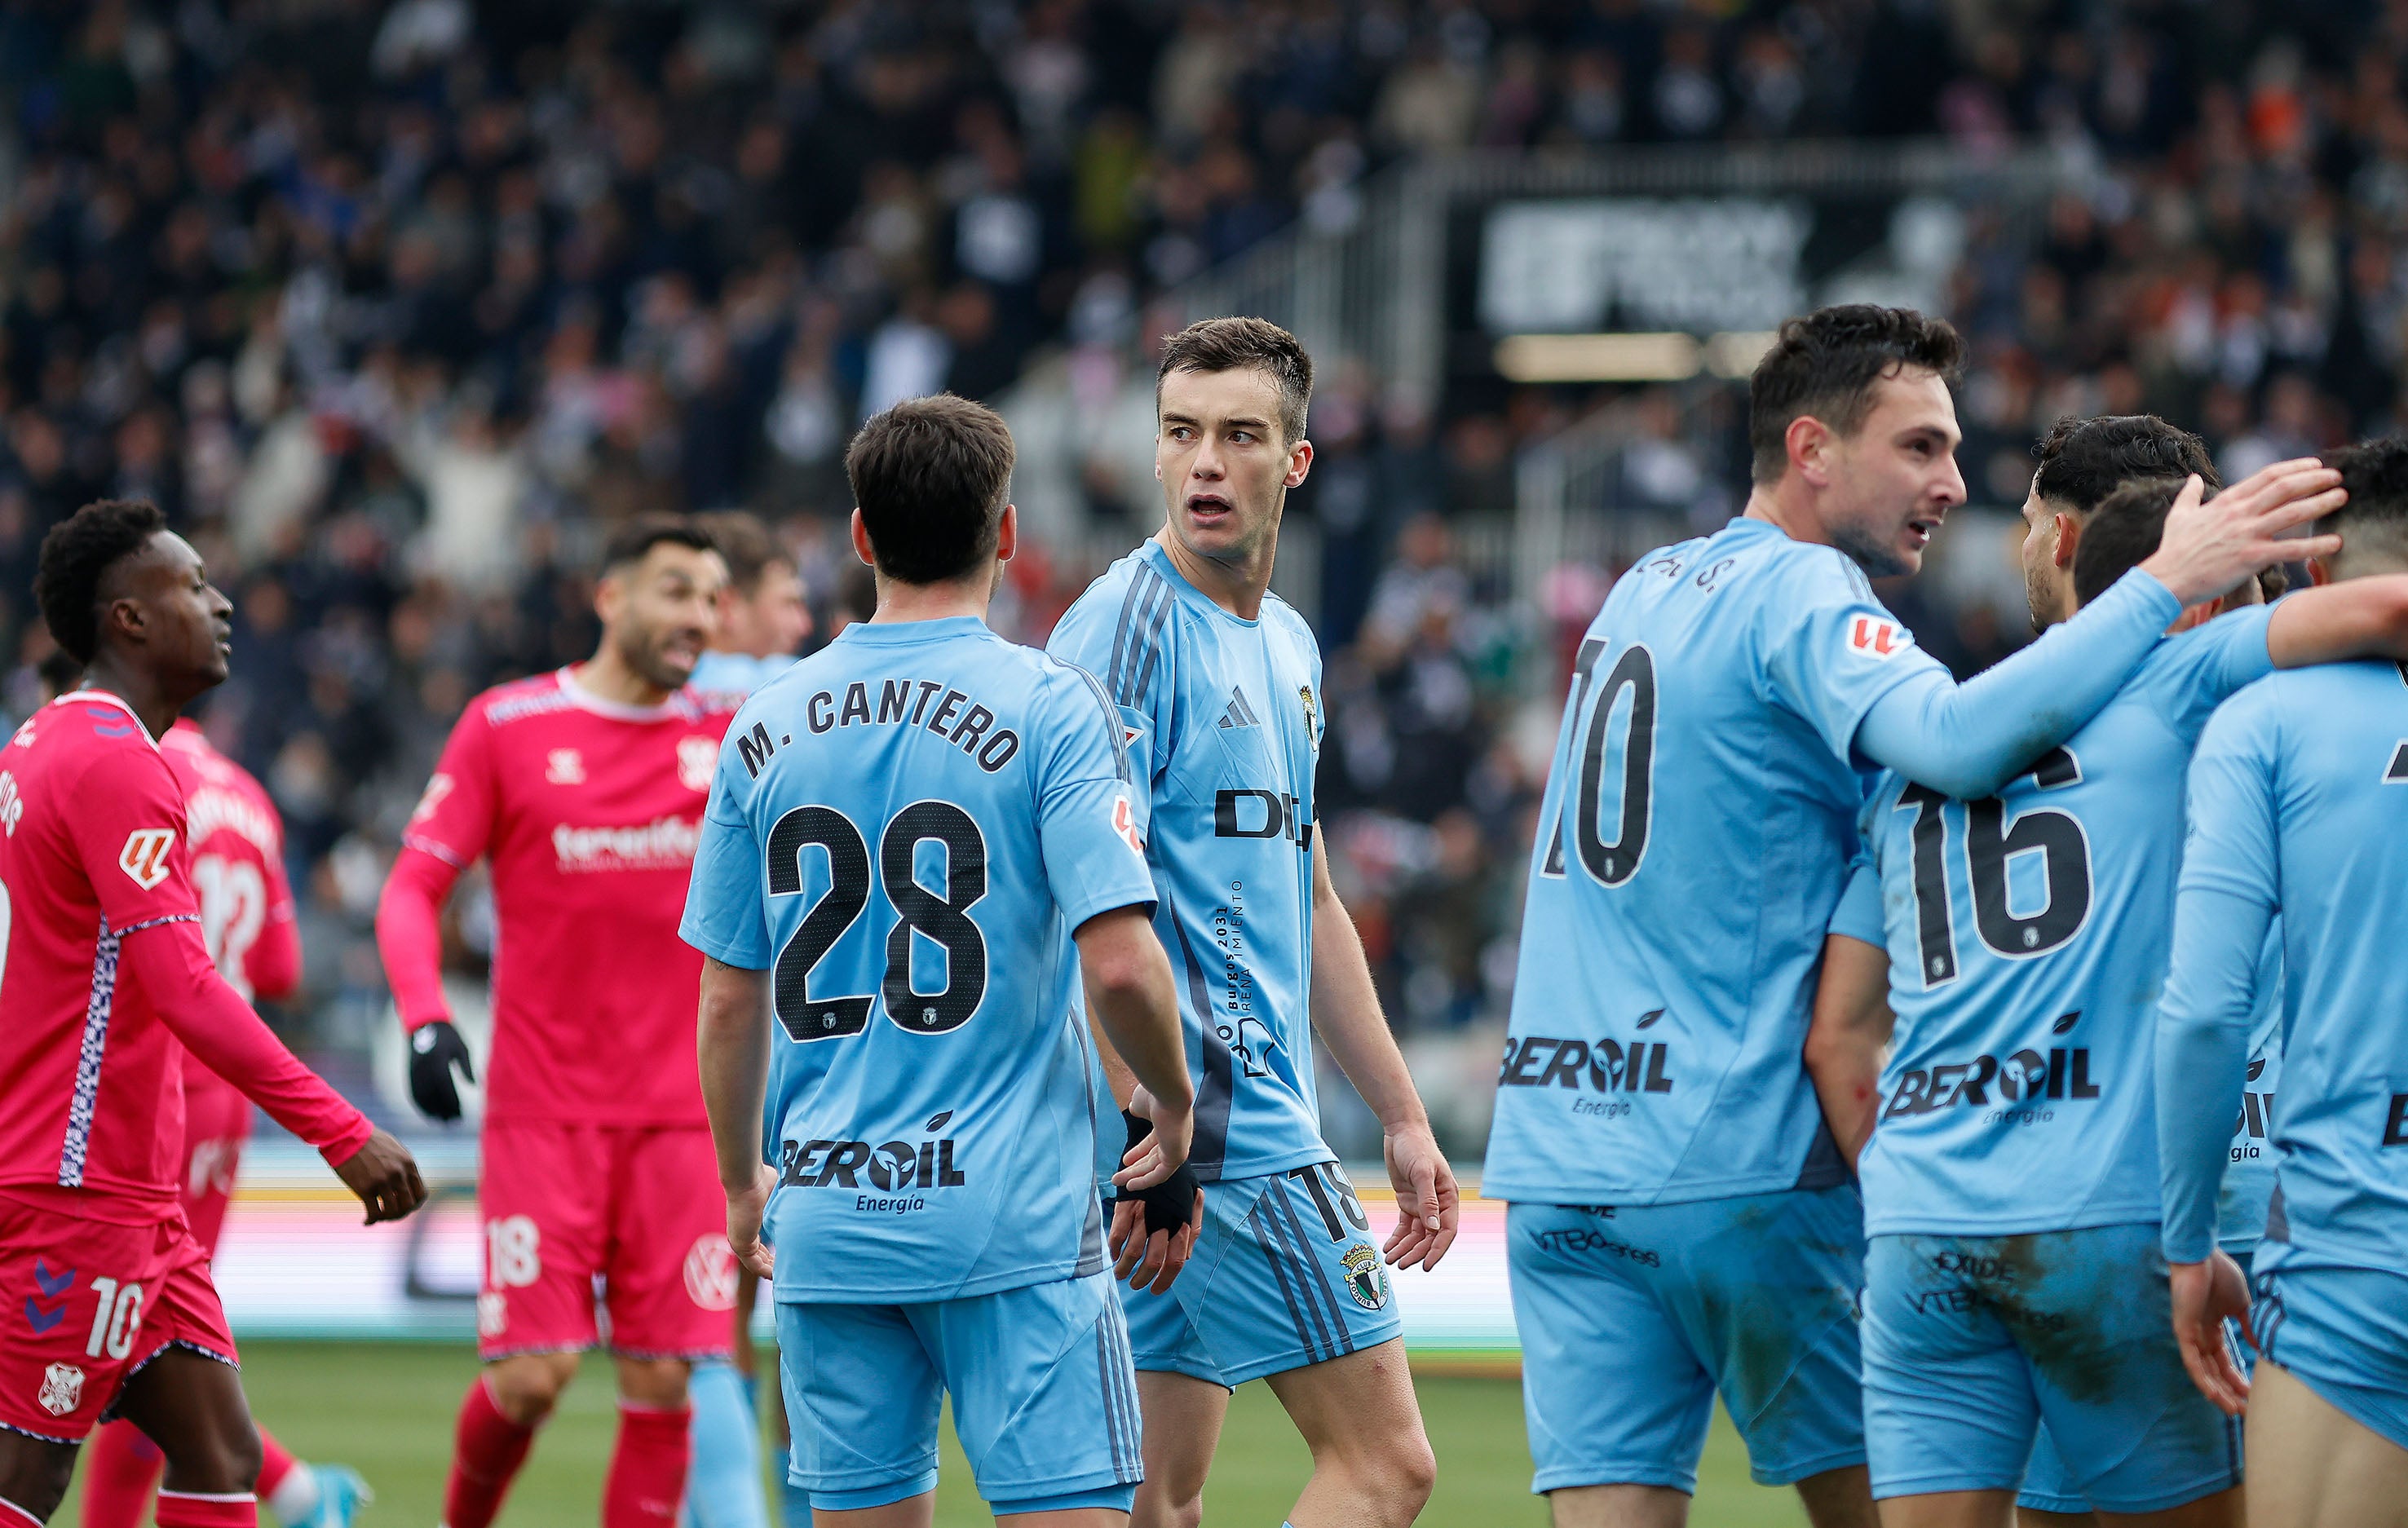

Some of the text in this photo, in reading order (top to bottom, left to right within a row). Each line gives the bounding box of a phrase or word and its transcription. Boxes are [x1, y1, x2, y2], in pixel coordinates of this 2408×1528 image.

[735, 678, 1020, 782] M. CANTERO
[1539, 634, 1659, 890] 10
[1892, 744, 2096, 993] 16
[765, 798, 989, 1044] 28
[1215, 906, 1239, 1010] Burgos 2031
[1230, 880, 1253, 1012] RENAIMIENTO
[855, 1194, 925, 1215] Energía
[1287, 1162, 1371, 1244] 18
[486, 1213, 542, 1291] 18
[1350, 1281, 1372, 1307] BURGOS
[1356, 1260, 1372, 1271] CLUB
[85, 1275, 144, 1361] 10
